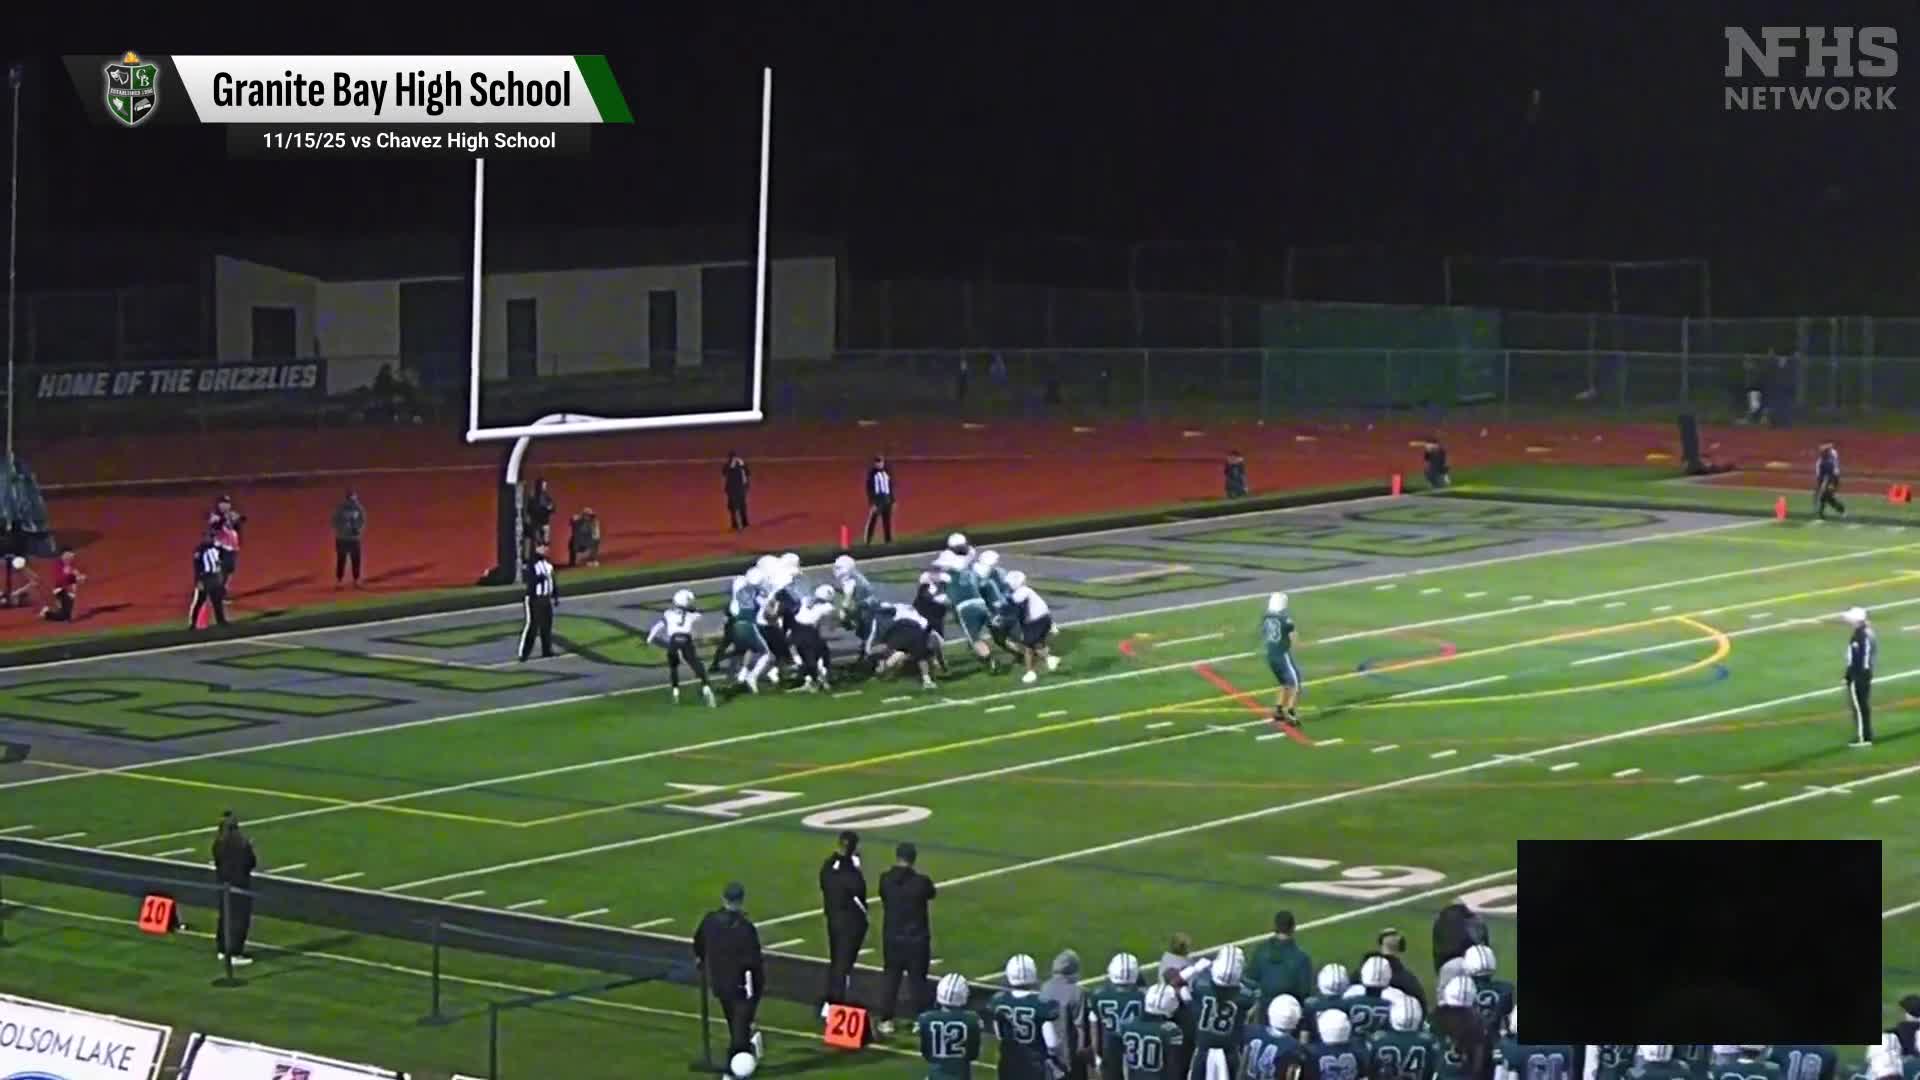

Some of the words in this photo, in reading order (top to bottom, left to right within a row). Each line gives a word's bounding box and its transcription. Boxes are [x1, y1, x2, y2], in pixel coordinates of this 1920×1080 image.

[38, 372, 110, 398] HOME
[113, 370, 145, 395] OF
[149, 368, 193, 393] THE
[197, 364, 317, 392] GRIZZLIES
[143, 899, 166, 925] 10
[831, 1008, 860, 1038] 20
[1098, 999, 1142, 1033] 54
[1199, 995, 1238, 1034] 18
[0, 1020, 74, 1058] OLSOM
[75, 1035, 136, 1071] LAKE
[929, 1020, 968, 1058] 12
[1122, 1031, 1164, 1072] 30
